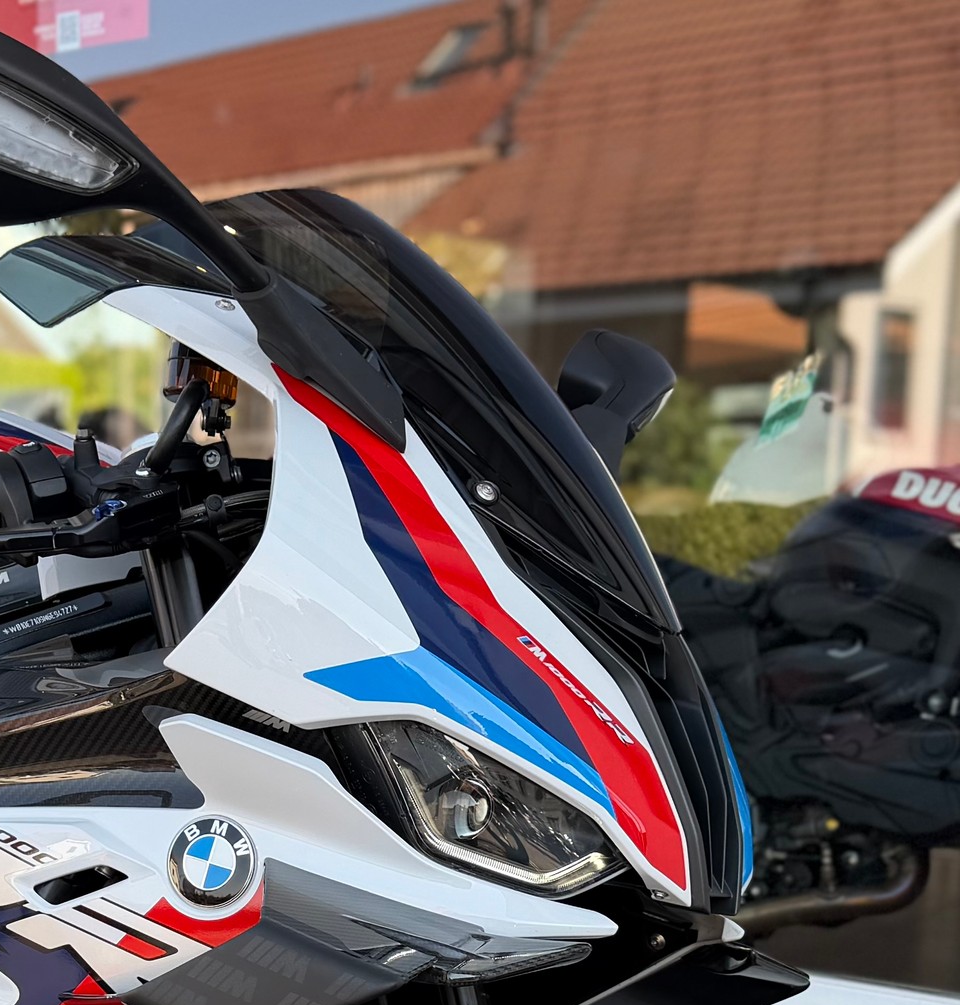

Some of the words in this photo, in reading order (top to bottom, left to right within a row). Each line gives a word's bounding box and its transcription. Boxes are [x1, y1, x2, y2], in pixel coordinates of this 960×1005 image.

[543, 661, 587, 700] 1000
[584, 699, 635, 745] RR
[183, 819, 250, 857] BMW
